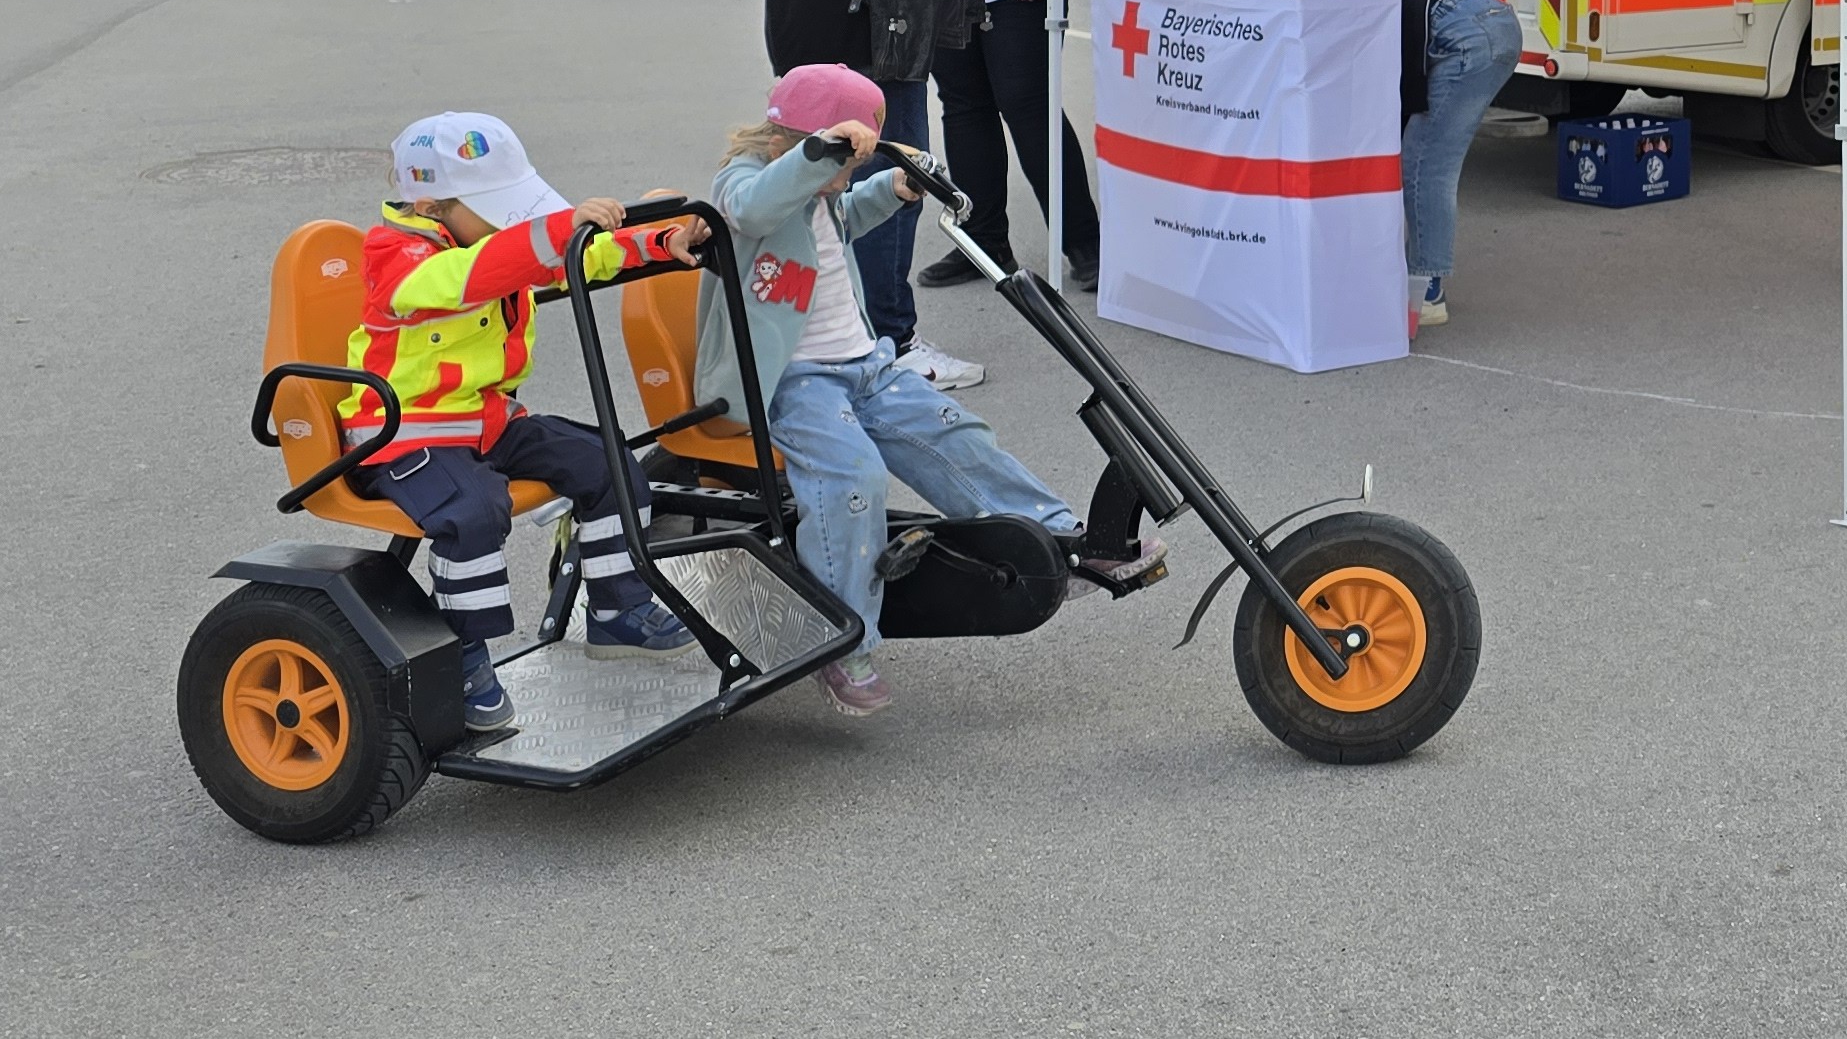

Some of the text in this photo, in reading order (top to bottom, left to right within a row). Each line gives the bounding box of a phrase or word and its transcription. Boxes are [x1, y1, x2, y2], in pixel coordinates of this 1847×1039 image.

[1160, 7, 1264, 42] Bayerisches
[1158, 33, 1206, 63] Rotes
[1157, 61, 1203, 92] Kreuz
[1156, 95, 1211, 115] Kreisverband
